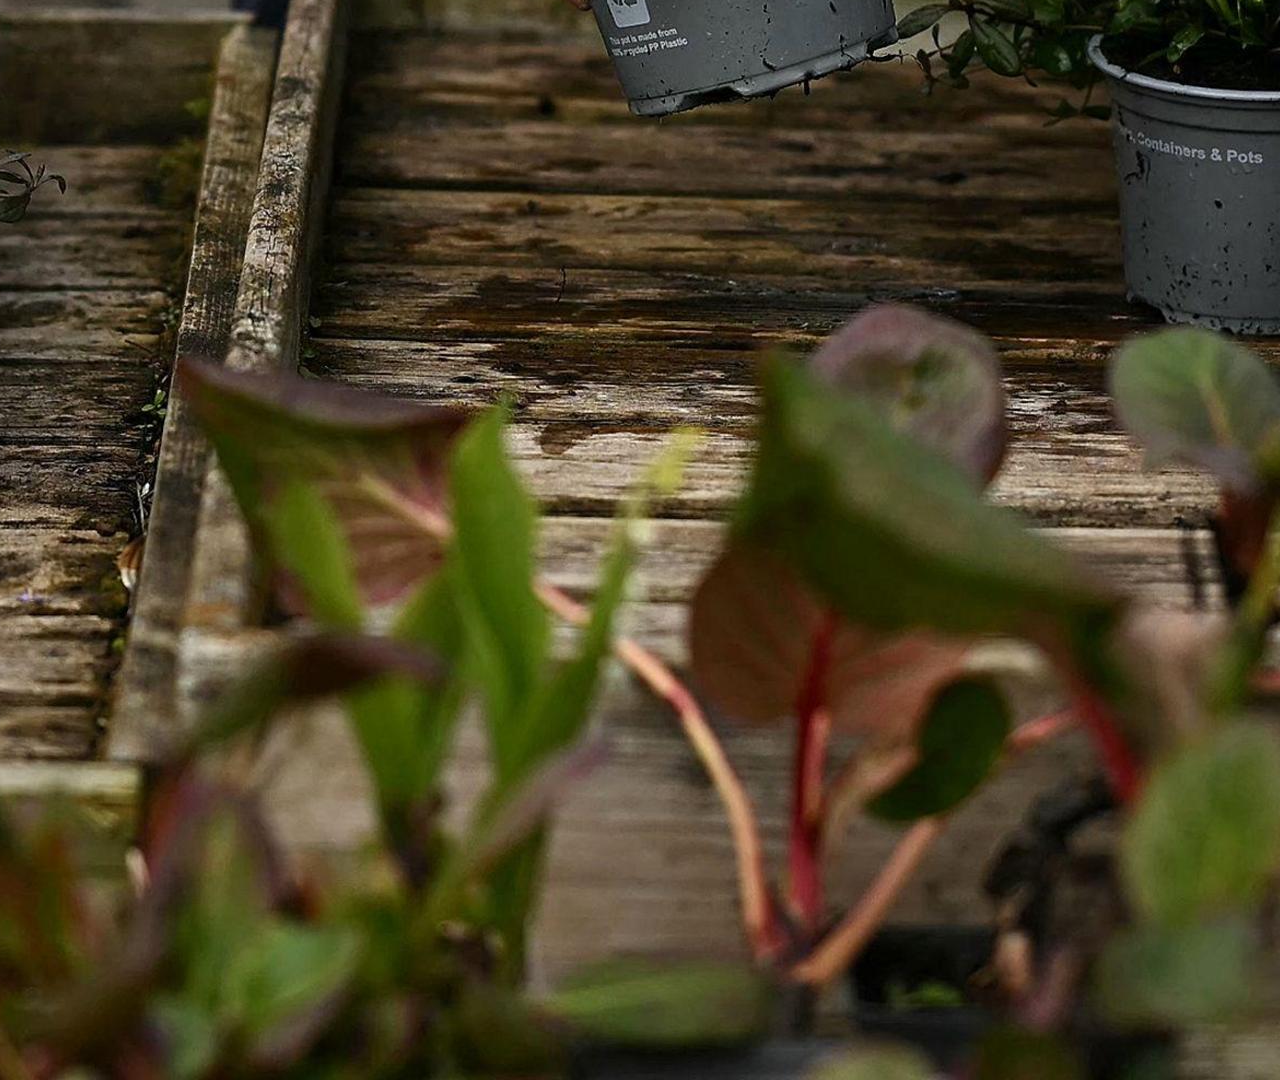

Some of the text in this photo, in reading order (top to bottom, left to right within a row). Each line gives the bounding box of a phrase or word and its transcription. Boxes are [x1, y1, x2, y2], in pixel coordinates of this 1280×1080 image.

[657, 28, 678, 38] from
[660, 37, 688, 50] Plastic
[1137, 131, 1207, 160] Containers
[1210, 148, 1223, 162] &
[1226, 150, 1264, 164] Pots
